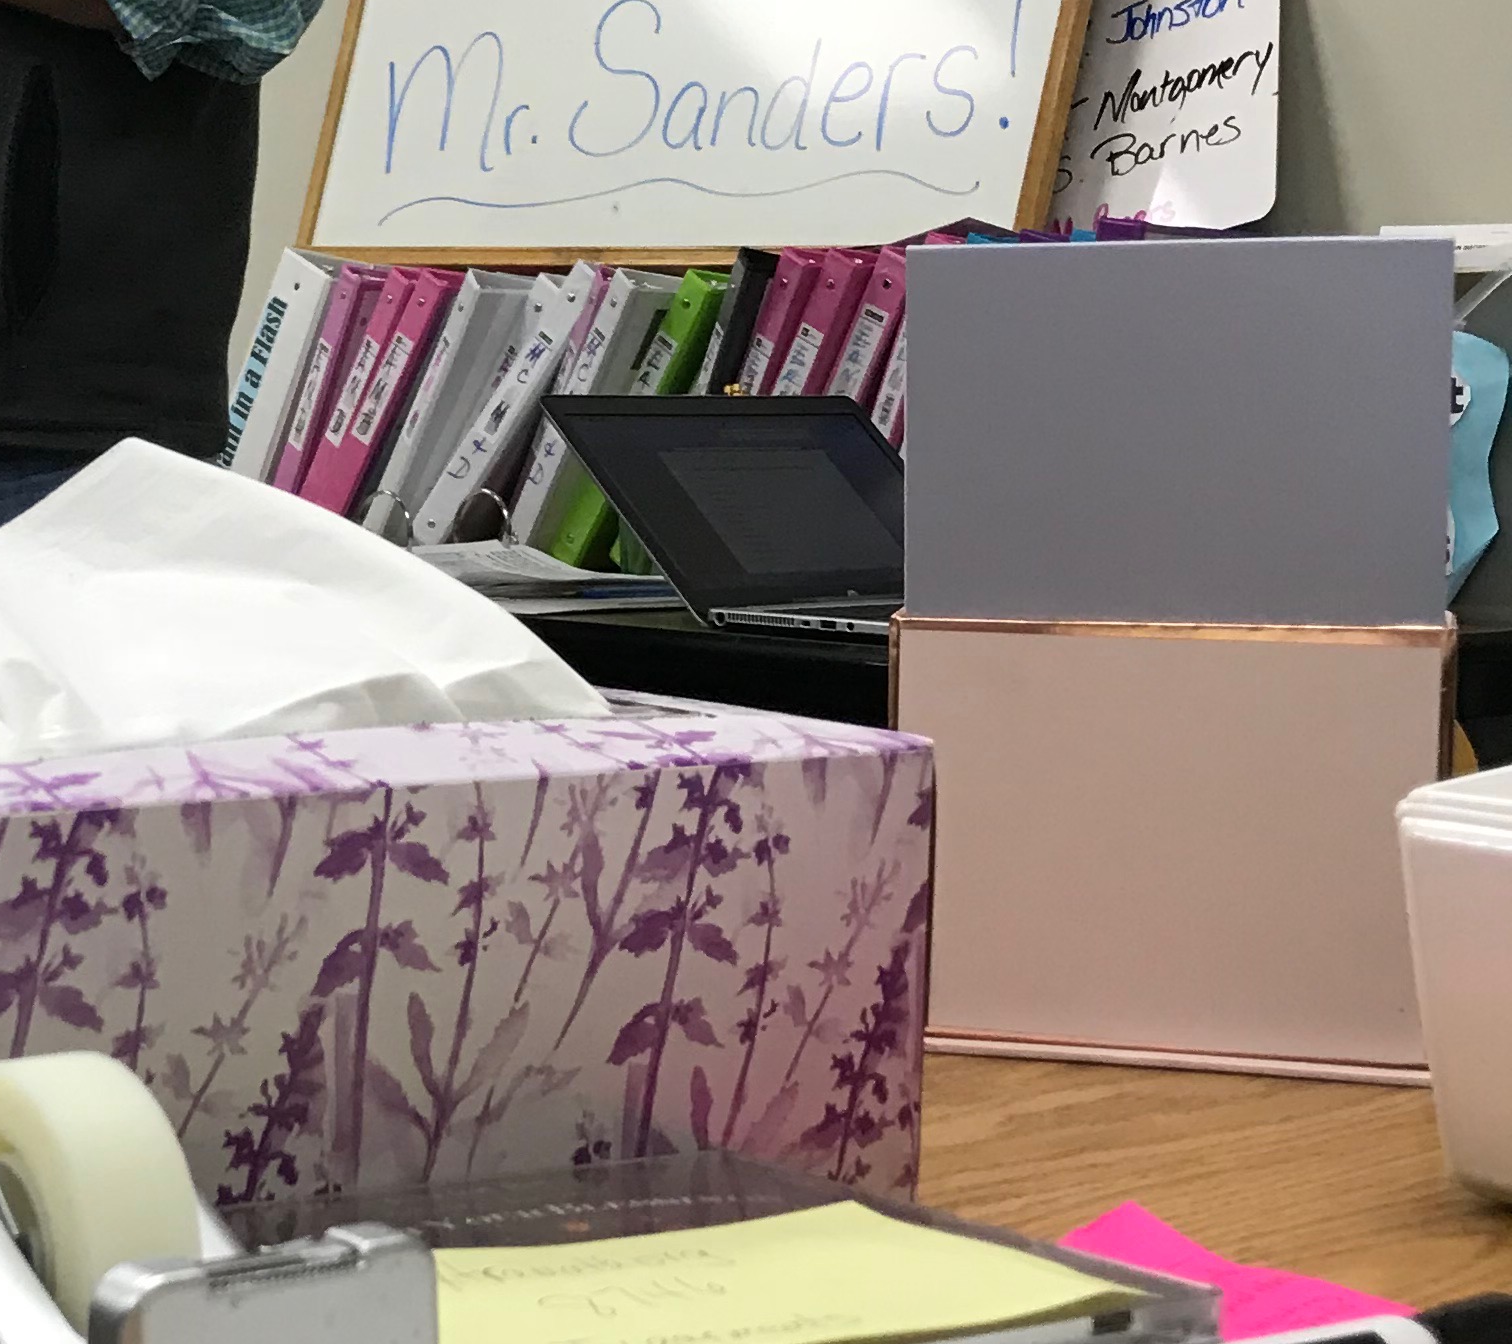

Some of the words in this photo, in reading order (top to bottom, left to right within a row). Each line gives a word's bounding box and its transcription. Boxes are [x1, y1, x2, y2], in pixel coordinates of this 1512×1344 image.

[383, 31, 541, 174] Mr.
[1092, 41, 1275, 132] Montgomery
[1089, 115, 1243, 177] Barnes
[250, 295, 289, 367] Flash
[230, 391, 255, 422] in
[244, 368, 263, 390] a
